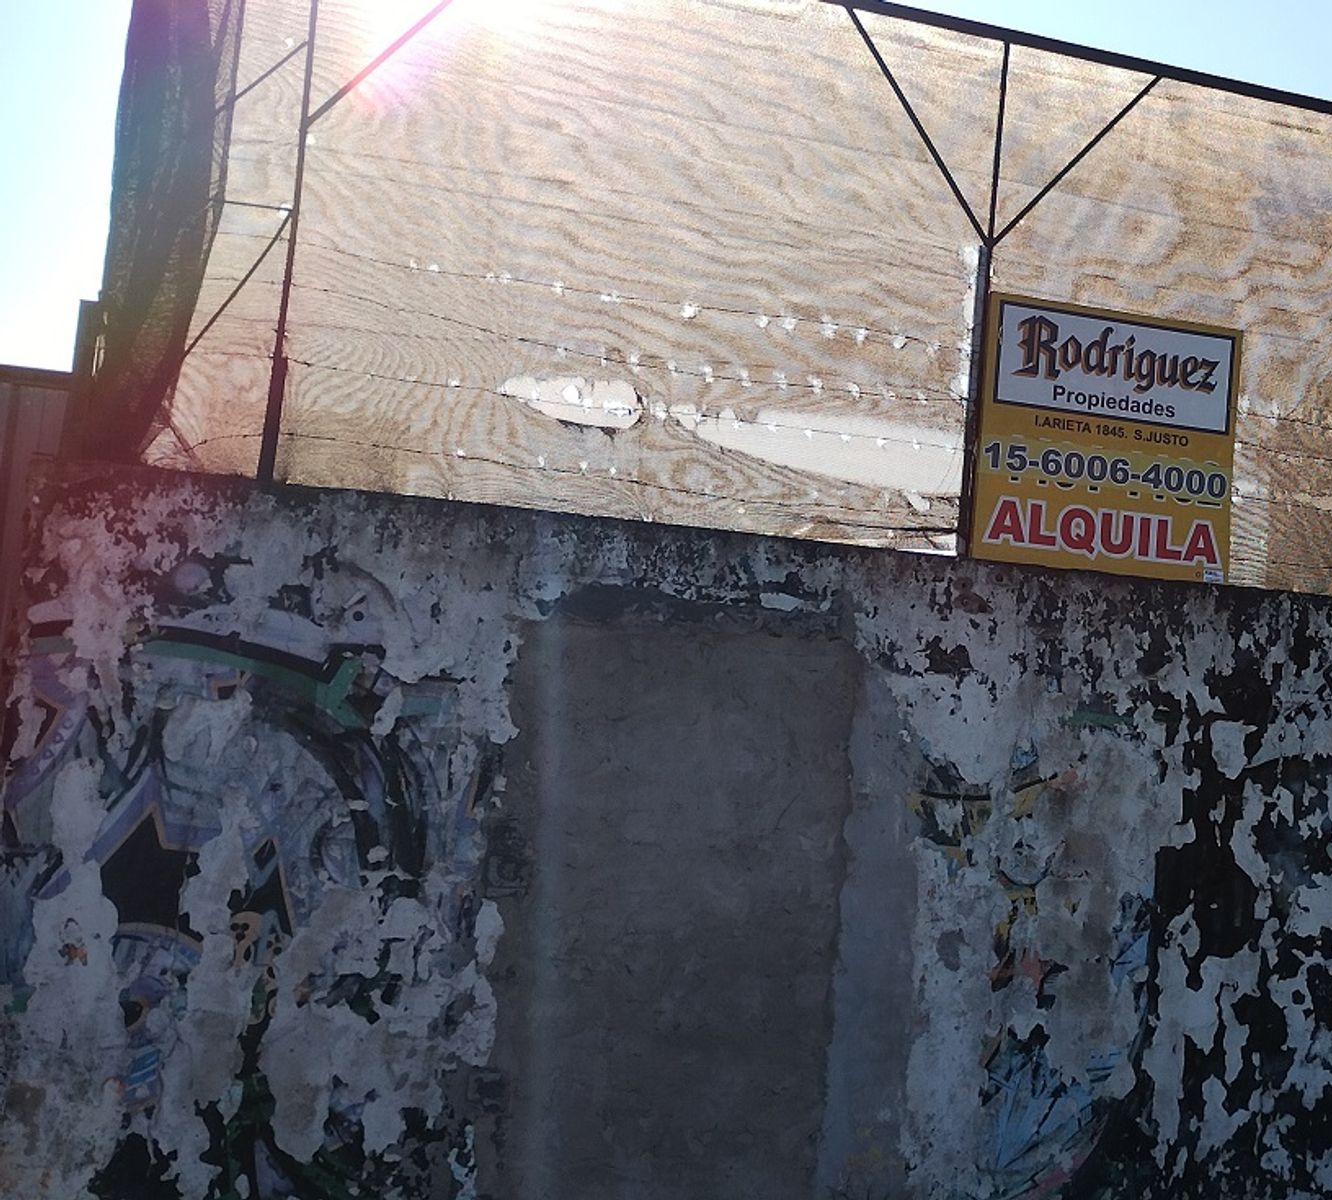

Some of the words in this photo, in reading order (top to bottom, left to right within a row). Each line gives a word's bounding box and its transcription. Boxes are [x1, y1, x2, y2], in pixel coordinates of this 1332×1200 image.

[1010, 314, 1221, 395] Rodriguez
[1052, 385, 1176, 418] Propiedades
[1034, 415, 1092, 434] I.ARIETA
[1133, 429, 1189, 447] S.JUSTO
[983, 441, 1227, 499] 15-6006-4000
[986, 497, 1219, 566] ALQUILA
